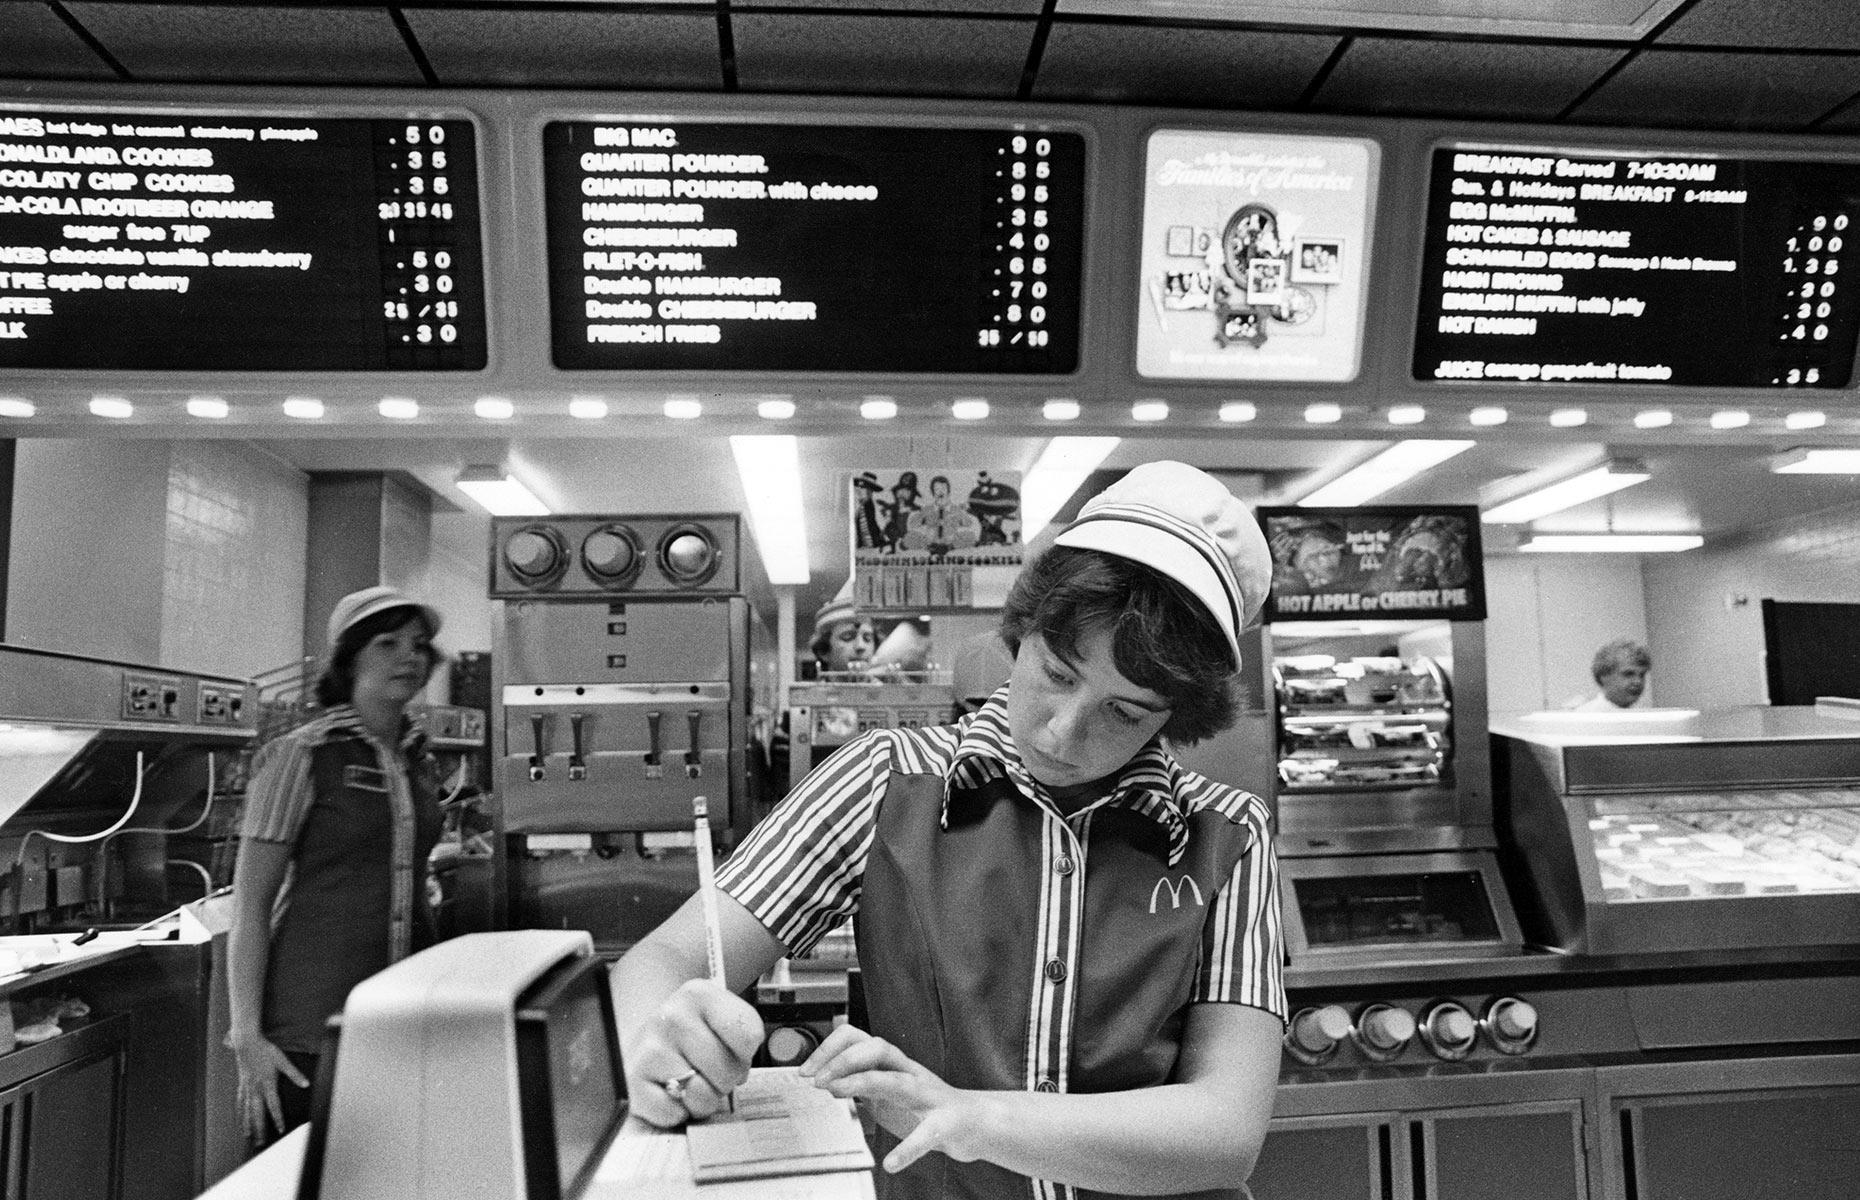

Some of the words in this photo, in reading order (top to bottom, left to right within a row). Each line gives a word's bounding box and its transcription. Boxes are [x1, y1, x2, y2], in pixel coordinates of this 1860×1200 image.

[594, 128, 629, 146] BIG
[122, 148, 213, 167] COOKIES
[581, 153, 670, 172] QUARTER
[1453, 154, 1554, 175] BREAKFAST
[1556, 159, 1615, 178] Served
[89, 172, 137, 191] CHIP
[145, 174, 234, 193] COOKIES
[582, 178, 670, 197] QUARTER
[768, 182, 808, 199] with
[810, 182, 877, 200] cheese
[1491, 180, 1503, 196] &
[1510, 181, 1576, 200] Holidays
[1580, 184, 1676, 202] BREAKFAST
[191, 200, 274, 219] ORANGE
[583, 203, 703, 222] HAMBURGER
[1450, 202, 1487, 219] EGG
[63, 225, 119, 242] sugar
[171, 225, 210, 243] 7UP
[583, 228, 737, 246] CHEESEBURGER
[1447, 225, 1483, 242] HOT
[1483, 226, 1539, 244] CAKES
[1540, 229, 1553, 245] &
[1555, 229, 1630, 247] SAUSAGE
[50, 247, 144, 265] chocolate
[146, 249, 209, 266] vanilla
[212, 250, 312, 270] strawberry
[1447, 248, 1548, 267] SCRAMBLED
[1549, 252, 1595, 269] EGGS
[11, 272, 46, 290] PIE
[48, 272, 102, 291] apple
[104, 275, 127, 289] or
[128, 273, 189, 293] cherry
[584, 276, 651, 294] Double
[655, 277, 781, 296] HAMBURGER
[1443, 271, 1490, 288] HASH
[1492, 273, 1563, 291] BROWNS
[0, 297, 53, 314] FFEE
[586, 300, 652, 318] Double
[658, 300, 816, 320] CHEESEBURGER
[1442, 293, 1514, 311] ENGLISH
[1515, 295, 1577, 312] MUFFIN
[587, 325, 663, 343] FRENCH
[665, 325, 720, 343] FRIES
[1439, 316, 1474, 333] HOT
[1435, 361, 1484, 378] JUICE
[1485, 363, 1540, 380] orange
[1619, 364, 1671, 379] tomato
[1277, 594, 1312, 612] HOT
[1312, 592, 1361, 611] APPLE
[1361, 596, 1379, 610] or
[1379, 589, 1440, 610] CHERRY
[1441, 587, 1467, 608] PIE
